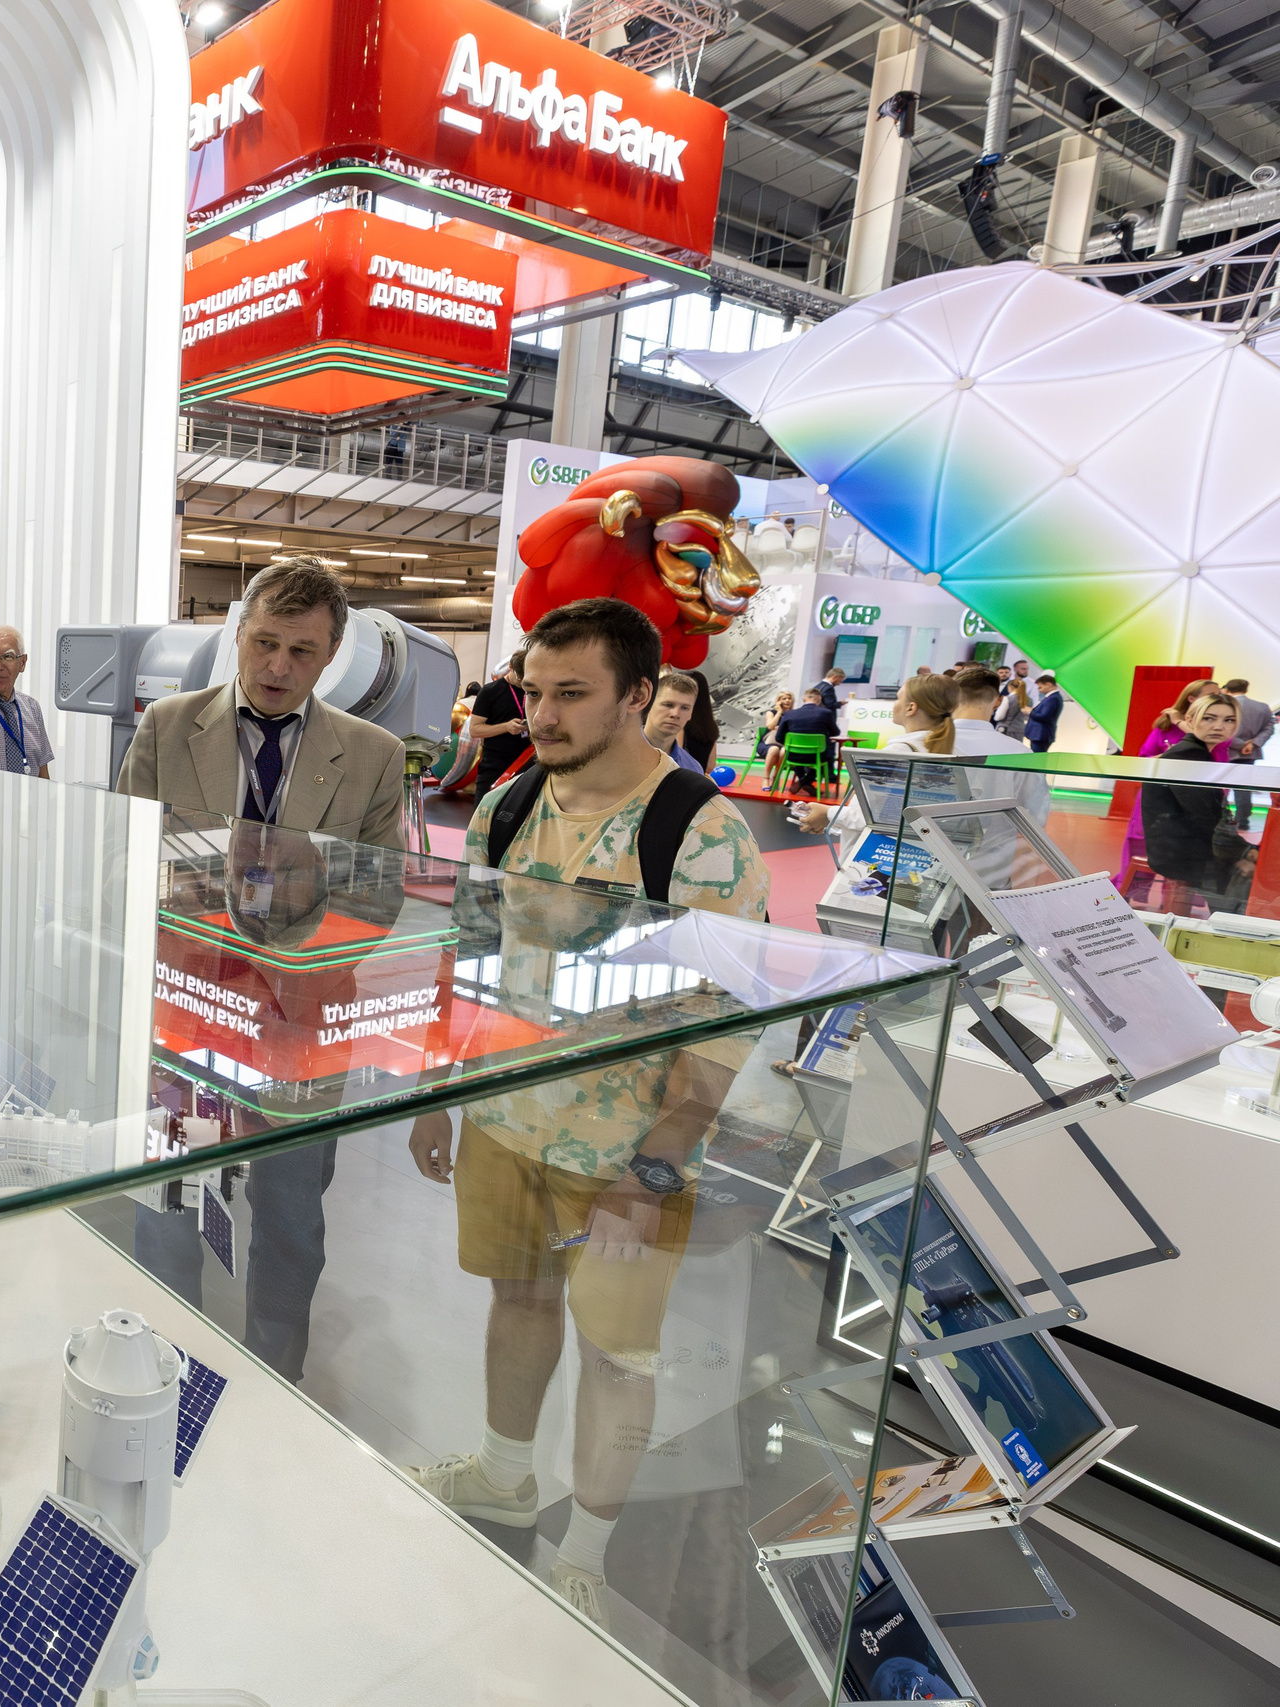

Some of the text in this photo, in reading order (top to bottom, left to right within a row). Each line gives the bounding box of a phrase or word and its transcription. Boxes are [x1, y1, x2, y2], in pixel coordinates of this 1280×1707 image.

[253, 259, 309, 297] БАНК
[368, 255, 504, 306] ЛУЧШИЙ БАНК
[181, 288, 302, 349] ДЛЯ БИЗНЕСА
[369, 282, 497, 330] ДЛЯ БИЗНЕСА
[840, 603, 881, 626] СБЕР
[871, 710, 894, 719] СБЕ
[874, 1612, 905, 1640] INNOPROM
